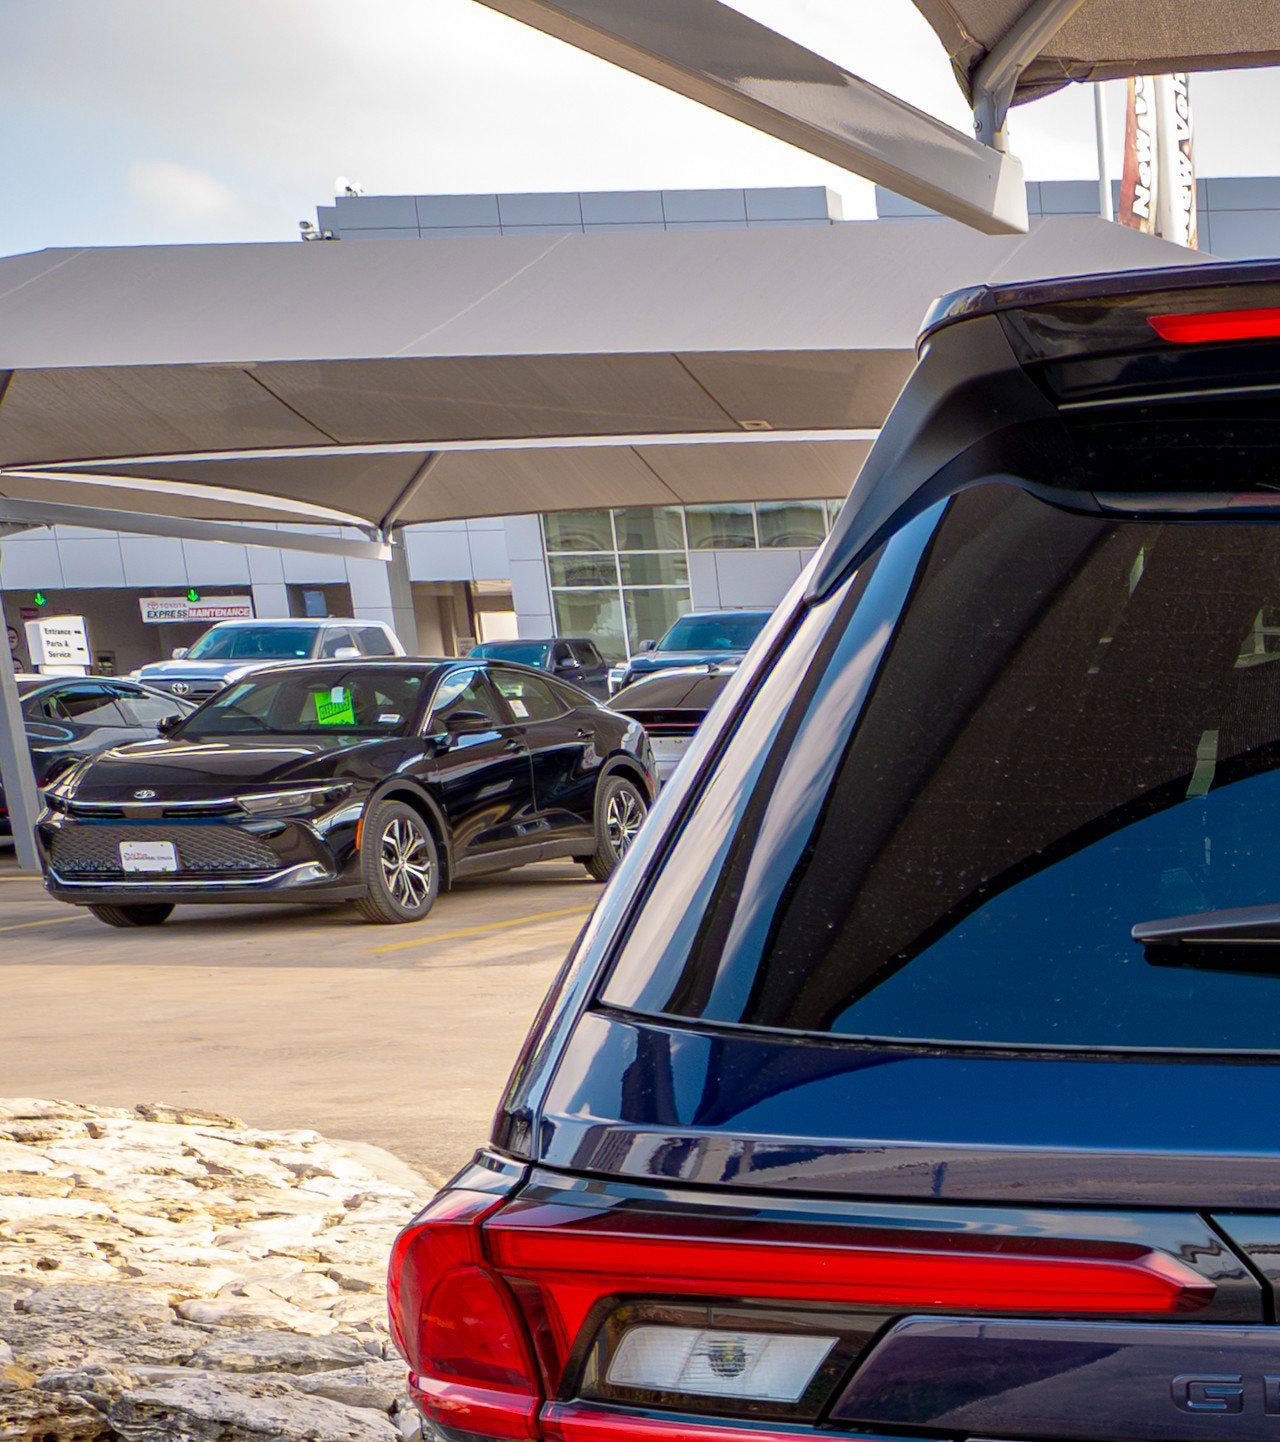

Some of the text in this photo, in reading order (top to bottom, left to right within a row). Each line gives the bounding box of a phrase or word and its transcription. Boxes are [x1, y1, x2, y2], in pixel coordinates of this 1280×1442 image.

[146, 606, 250, 619] EXPRESS MAINTENANCE
[44, 627, 71, 635] Entrance
[48, 650, 71, 658] Service
